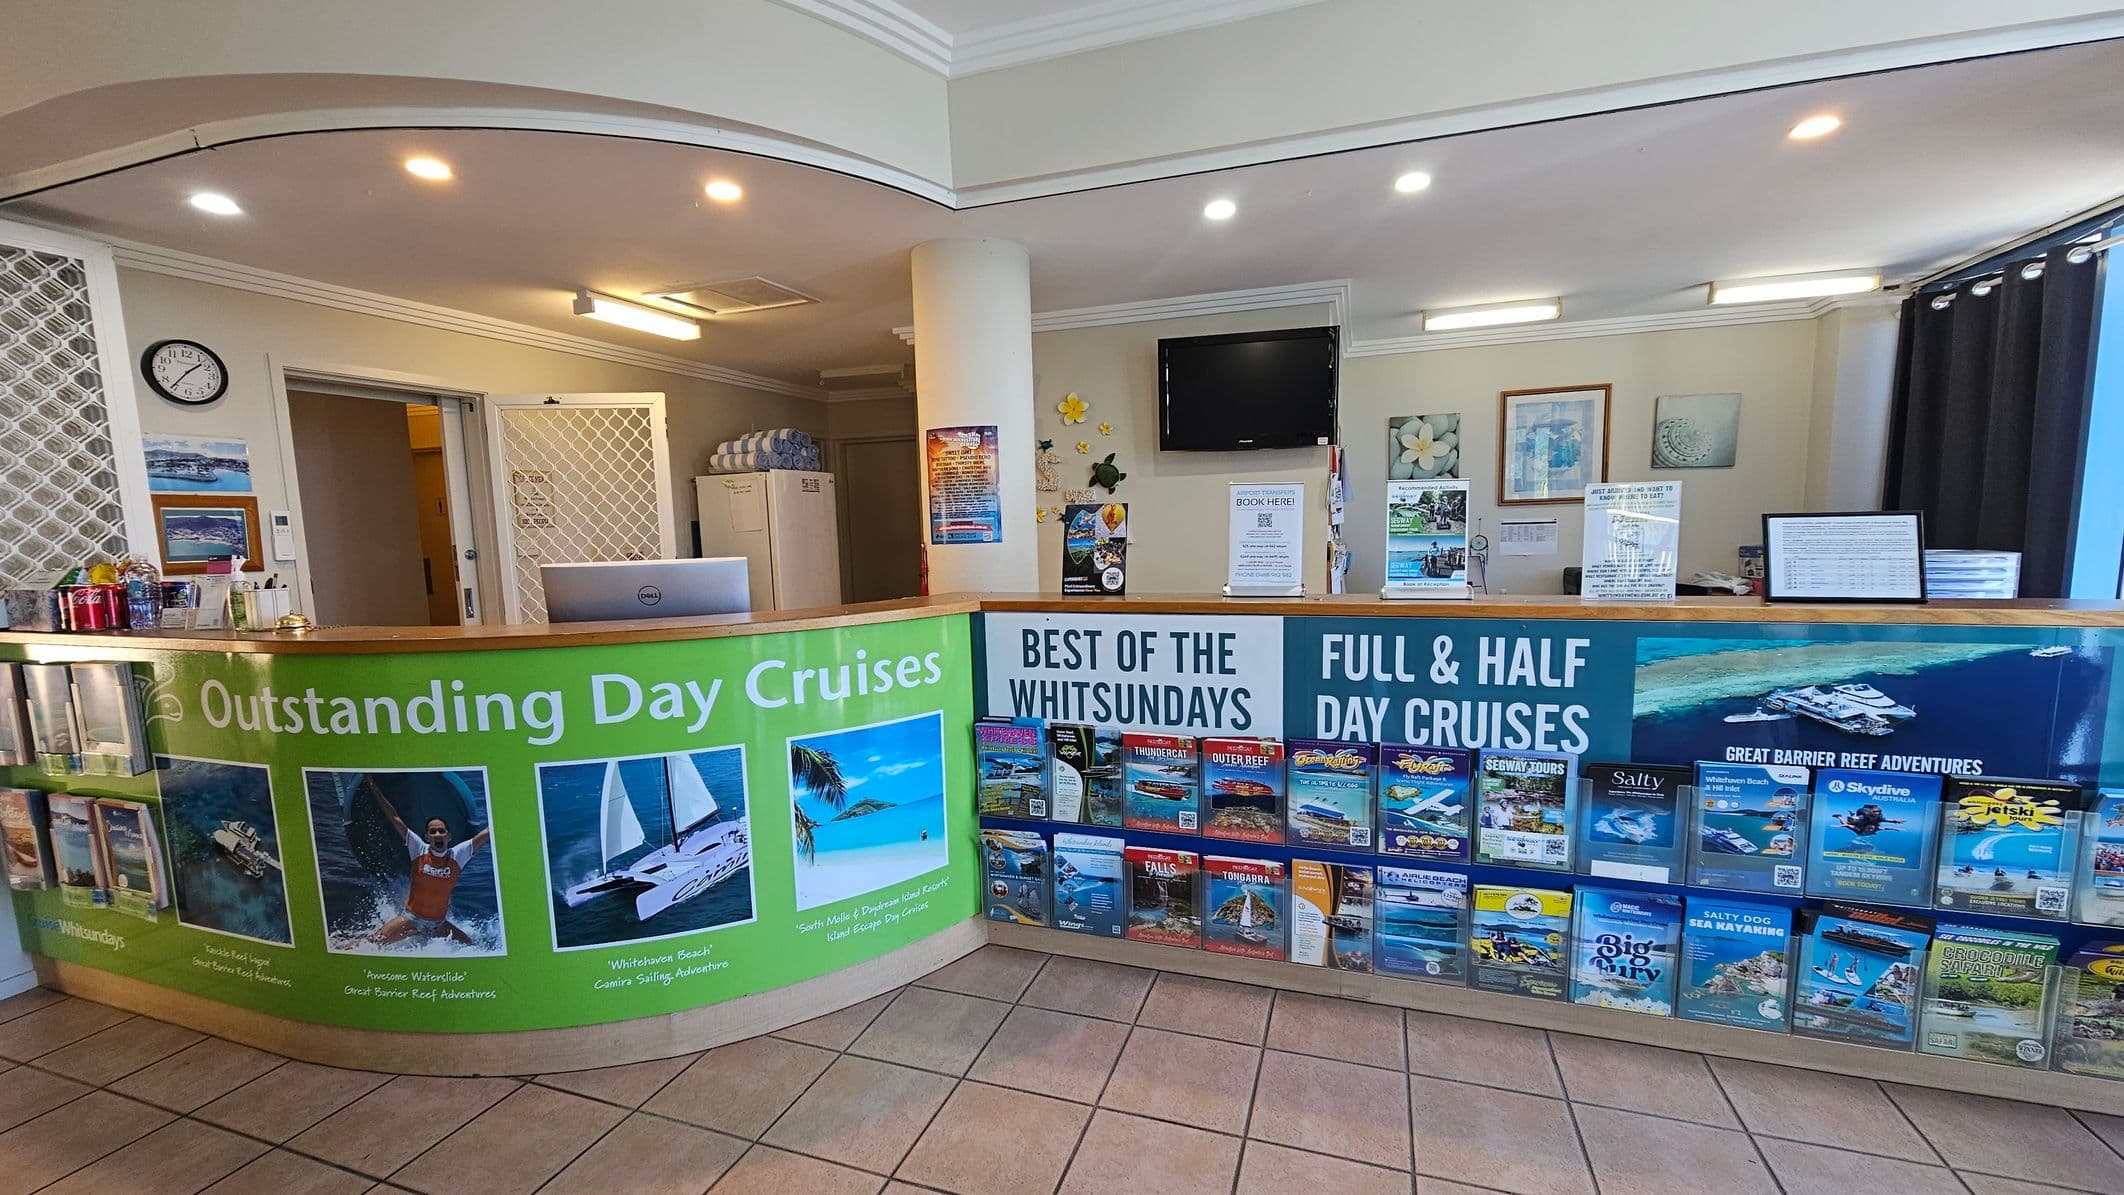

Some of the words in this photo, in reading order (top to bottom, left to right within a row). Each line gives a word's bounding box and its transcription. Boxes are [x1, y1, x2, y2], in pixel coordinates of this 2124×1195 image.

[1236, 498, 1265, 507] BOOK
[1267, 498, 1295, 506] HERE!
[1022, 628, 1105, 671] BEST
[1116, 630, 1161, 673] OF
[1169, 631, 1237, 675] THE
[1322, 633, 1416, 683] FULL
[1429, 634, 1459, 686] &
[1479, 637, 1591, 689] HALF
[200, 678, 564, 747] Outstanding
[590, 671, 722, 733] Day
[745, 649, 943, 710] Cruises
[1009, 678, 1253, 731] WHITSUNDAYS
[1317, 693, 1392, 744] DAY
[1404, 698, 1590, 755] CRUISES
[1133, 746, 1187, 759] THUNDERCAT
[1212, 752, 1243, 765] OUTER
[1245, 754, 1270, 766] REEF
[1725, 746, 1771, 764] GREAT
[1773, 749, 1836, 767] BARRIER
[1840, 752, 1876, 770] REEF
[1880, 754, 1983, 776] ADVENTURES
[1486, 758, 1528, 772] SEGWAY
[1529, 761, 1565, 775] TOURS
[1611, 771, 1664, 790] Salty
[1705, 776, 1745, 785] Whitehaven
[1746, 777, 1769, 786] Beach
[1846, 780, 1911, 798] Skydive
[1872, 795, 1916, 804] AUSTRALIA
[1985, 804, 2035, 817] jetski
[1145, 860, 1177, 874] FALLS
[1222, 870, 1270, 885] TONGARRA
[1402, 872, 1431, 880] AIRLIE
[1432, 875, 1466, 884] BEACH
[862, 898, 899, 917] Daydream
[901, 889, 920, 902] Island
[827, 928, 850, 942] Island
[853, 918, 882, 934] Escape
[885, 913, 900, 925] Day
[902, 901, 929, 917] Cruises
[1703, 910, 1740, 922] SALTY
[1743, 914, 1772, 925] DOG
[1689, 918, 1714, 929] SEA
[1716, 921, 1785, 937] KAYAKING
[1594, 933, 1654, 967] Big
[1942, 945, 2046, 969] CROCODILE
[594, 973, 633, 989] Camira
[635, 969, 674, 986] Sailing
[675, 959, 729, 979] Adventure
[1940, 958, 2004, 978] SAFARI
[344, 985, 373, 998] Great
[374, 986, 409, 999] Barrier
[412, 986, 437, 1002] Reef
[440, 987, 497, 1000] Adventures
